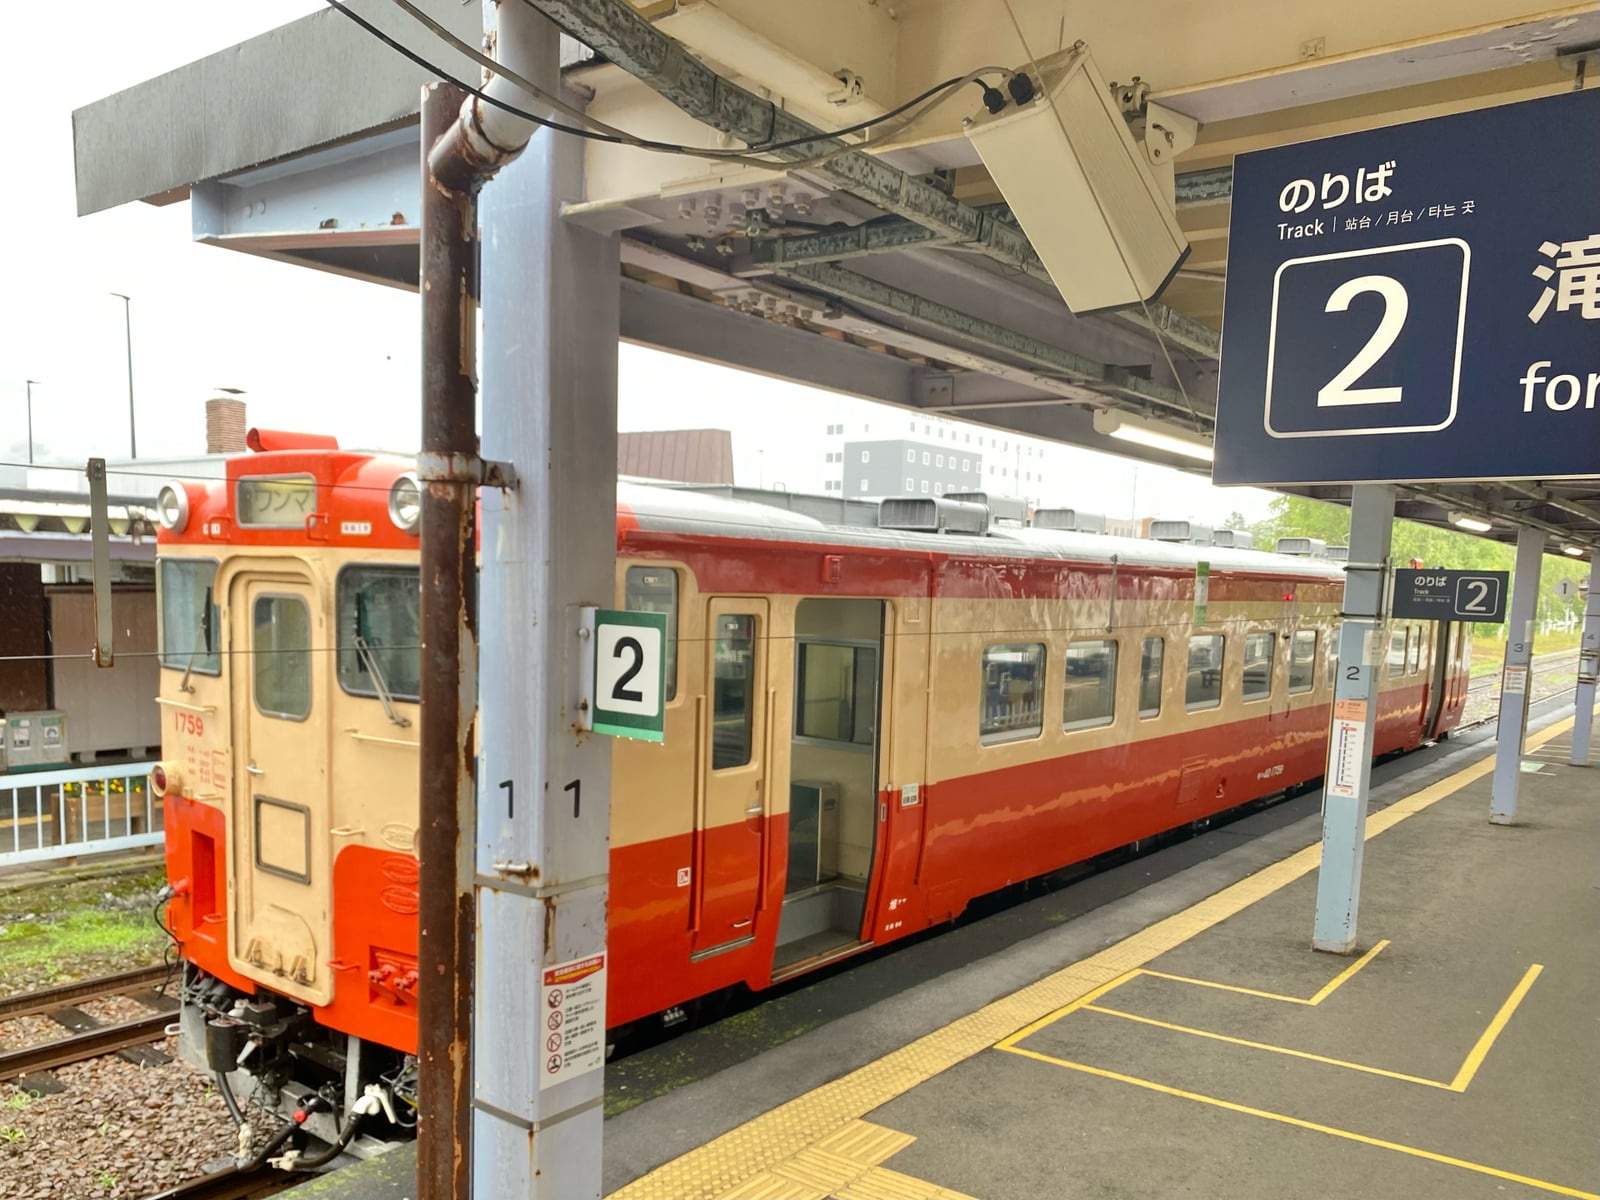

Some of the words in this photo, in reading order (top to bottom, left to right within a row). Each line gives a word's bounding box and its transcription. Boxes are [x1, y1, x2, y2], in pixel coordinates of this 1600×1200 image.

[1279, 160, 1397, 214] のりば
[1386, 209, 1414, 225] 月台
[1428, 203, 1456, 219] 타는
[1277, 219, 1324, 240] Track
[1316, 274, 1410, 408] 2
[1519, 360, 1600, 413] for
[254, 488, 315, 514] ワンマ
[1414, 576, 1447, 587] のりば
[1562, 582, 1568, 595] 1
[1465, 581, 1488, 611] 2
[1513, 643, 1524, 653] 3
[611, 636, 644, 702] 2
[1346, 666, 1360, 680] 2
[175, 711, 204, 737] 1759
[499, 779, 514, 819] 1
[564, 778, 580, 818] 1
